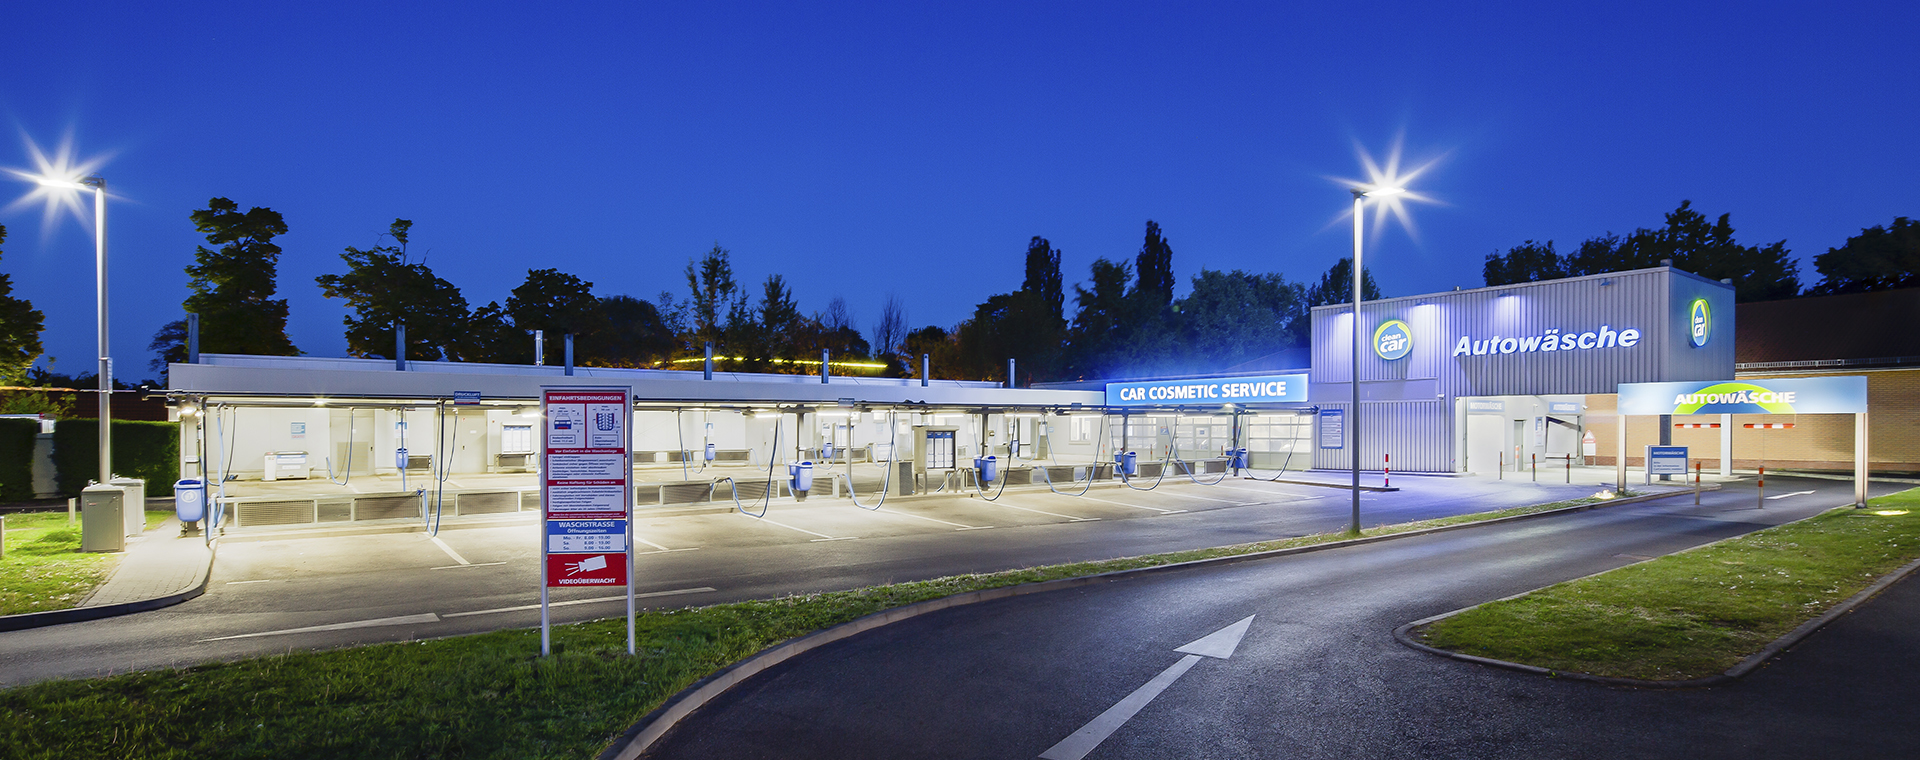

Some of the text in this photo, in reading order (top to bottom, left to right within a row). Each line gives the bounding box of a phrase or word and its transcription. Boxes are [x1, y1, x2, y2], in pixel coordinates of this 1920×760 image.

[1381, 333, 1402, 342] clean
[1694, 323, 1705, 337] car
[1380, 337, 1407, 353] car
[1453, 325, 1640, 358] Autowäsche
[1120, 381, 1287, 401] CAR COSMETIC SERVICE
[1673, 390, 1797, 405] AUTOWÄSCHE
